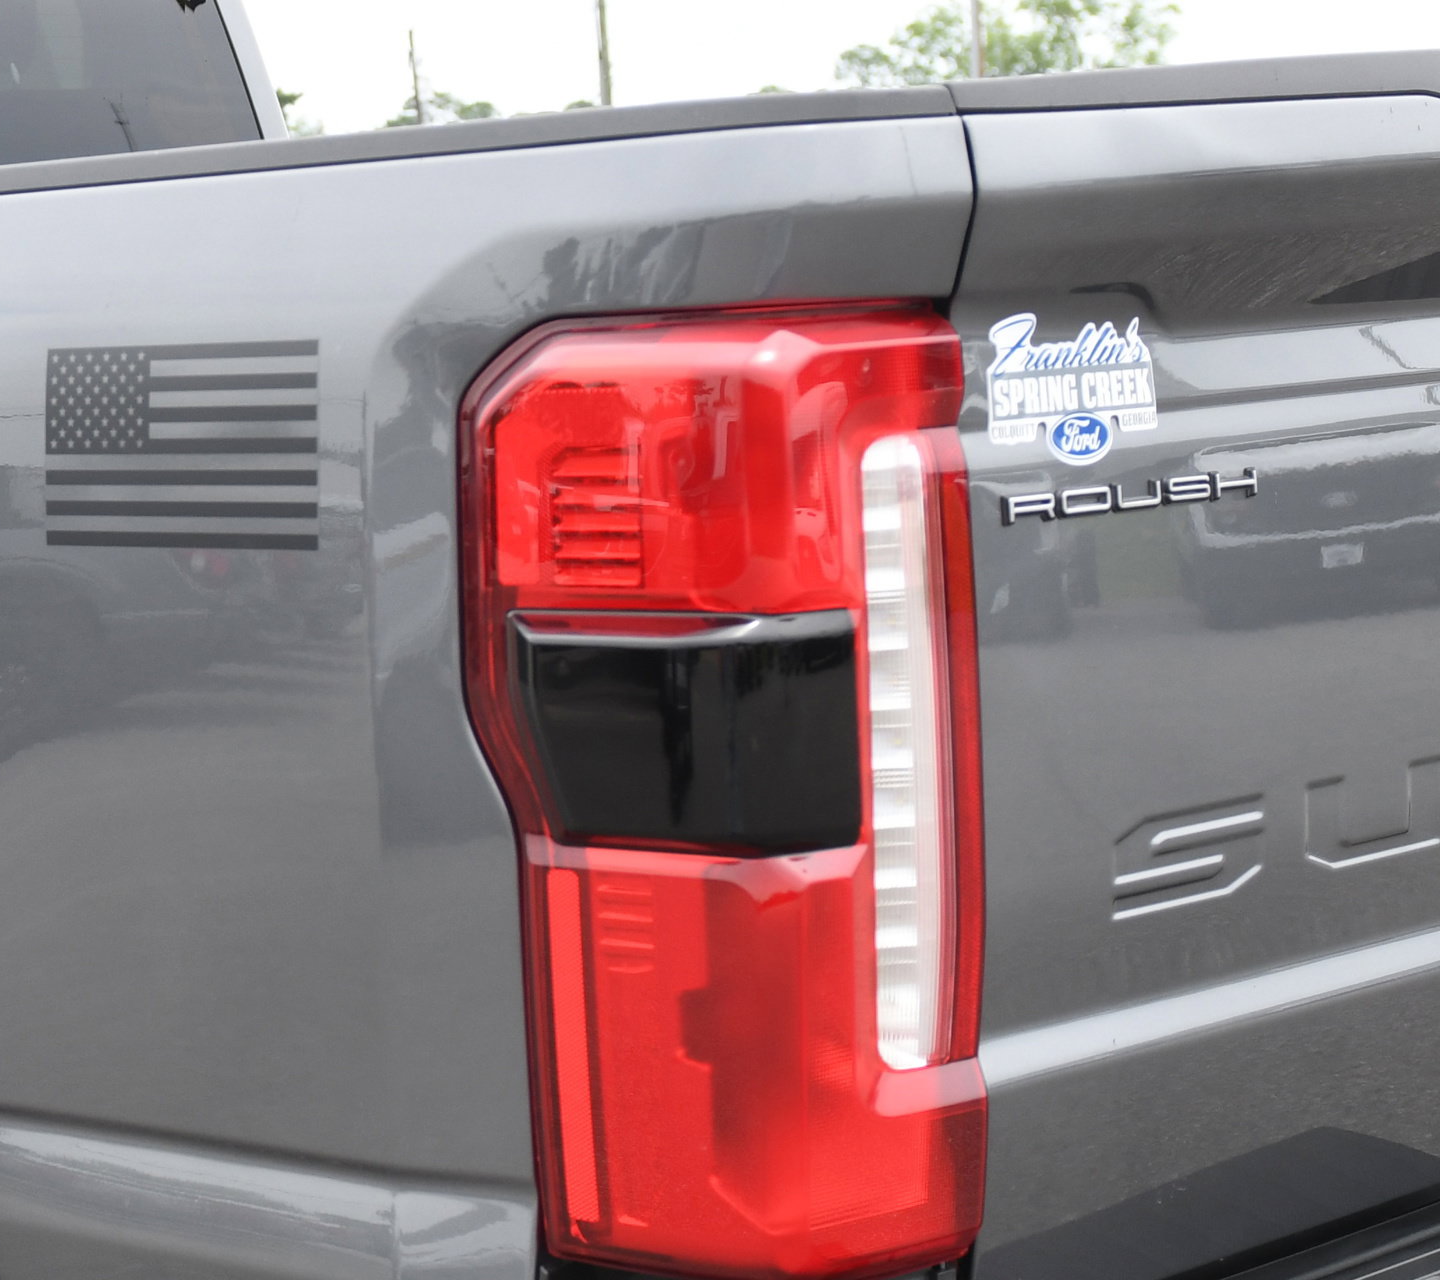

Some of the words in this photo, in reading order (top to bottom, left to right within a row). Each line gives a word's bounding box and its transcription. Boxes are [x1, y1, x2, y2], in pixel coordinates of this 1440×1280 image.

[993, 318, 1146, 377] Franklin's
[993, 374, 1079, 418] SPRING
[1081, 368, 1153, 409] CREEK
[1061, 418, 1101, 453] Ford
[1001, 467, 1258, 526] ROUSH
